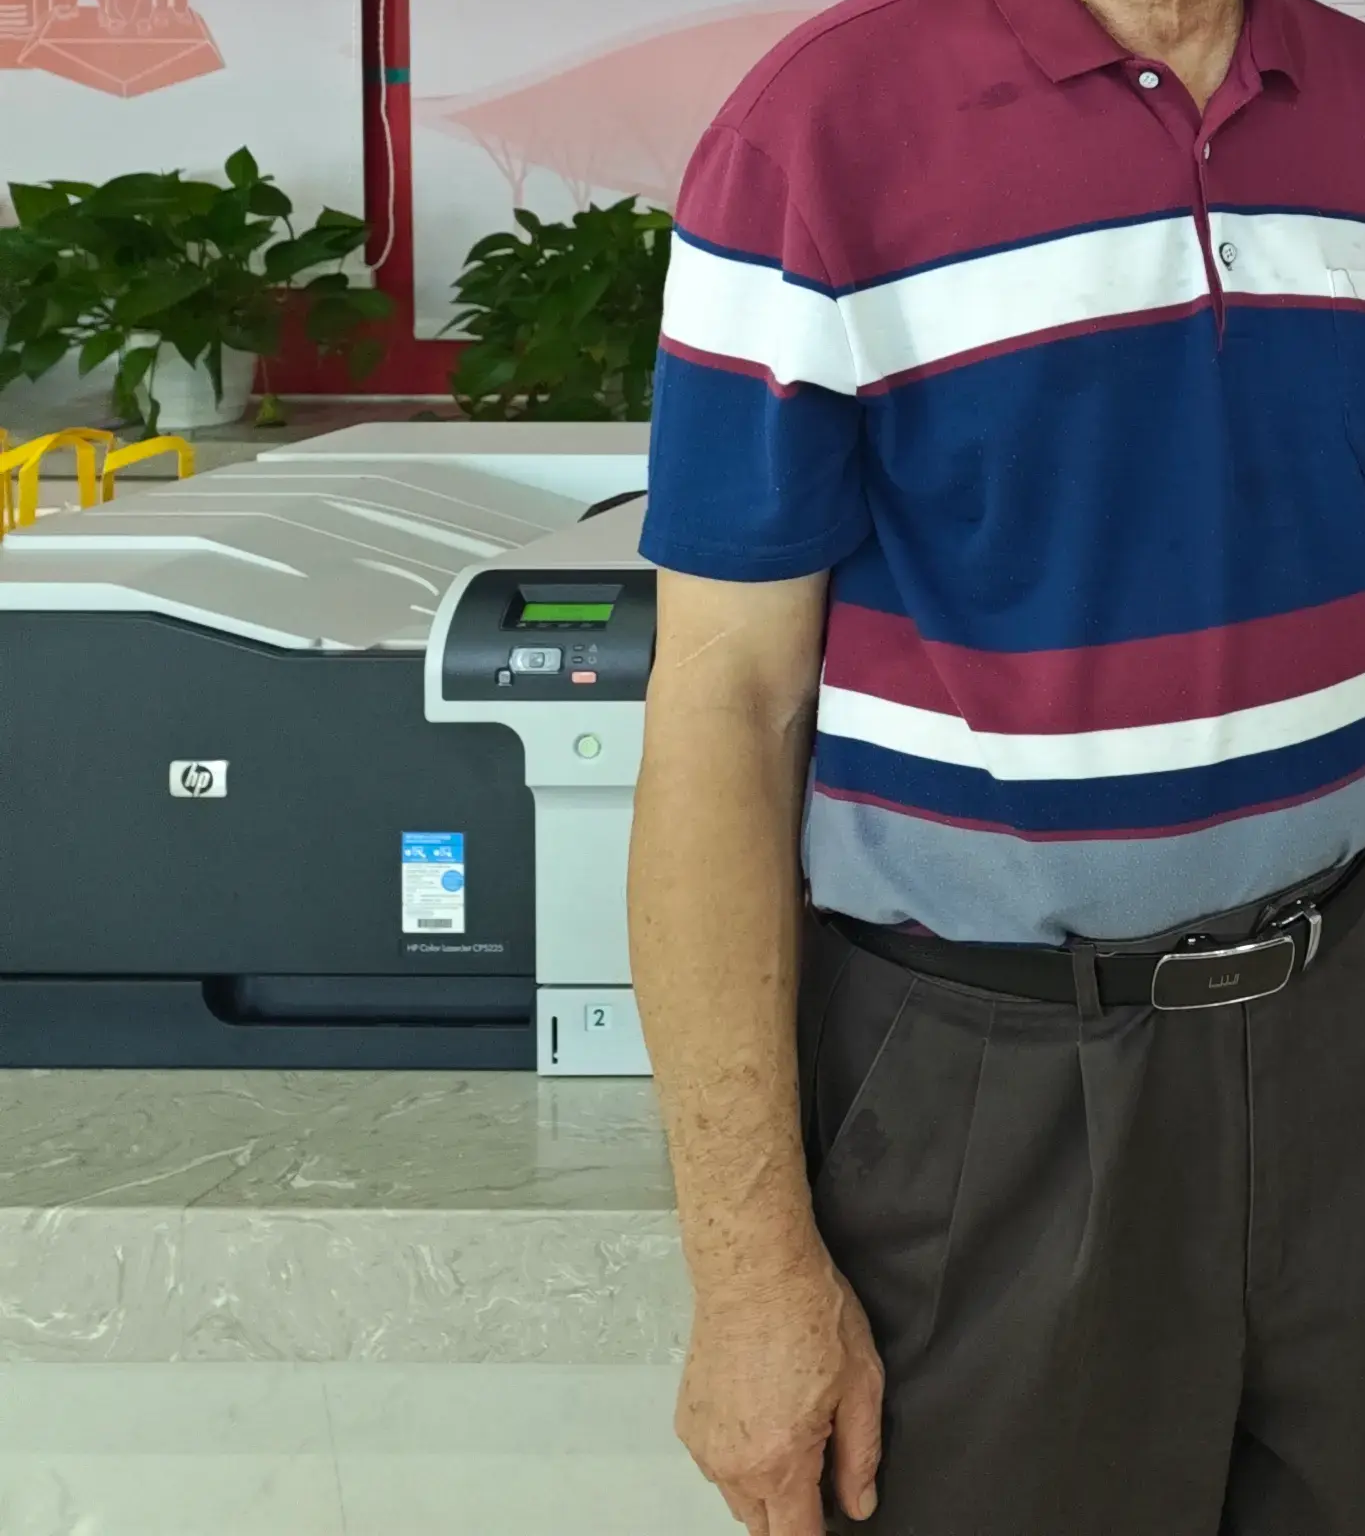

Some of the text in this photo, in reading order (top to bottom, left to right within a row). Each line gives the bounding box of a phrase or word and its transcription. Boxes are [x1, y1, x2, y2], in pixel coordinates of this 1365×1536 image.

[184, 762, 212, 797] hp
[421, 943, 441, 953] Color
[593, 1008, 605, 1027] 2
